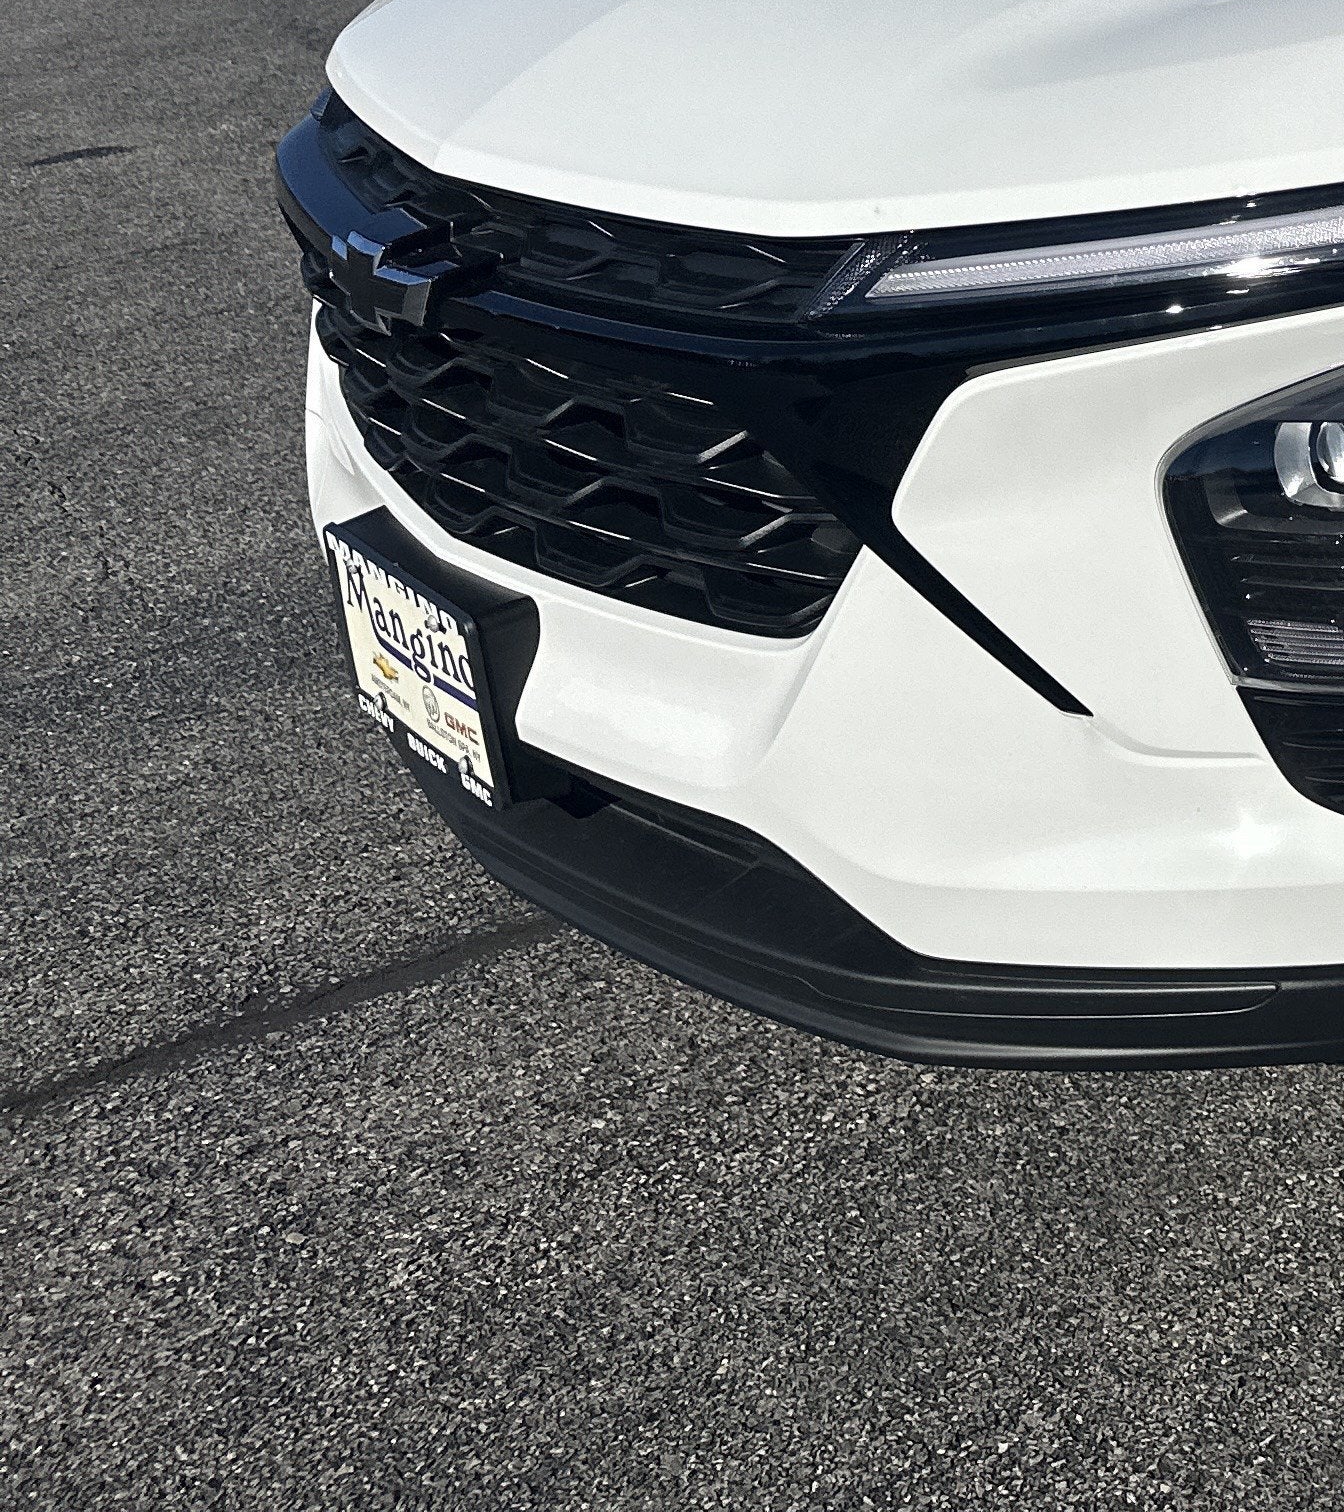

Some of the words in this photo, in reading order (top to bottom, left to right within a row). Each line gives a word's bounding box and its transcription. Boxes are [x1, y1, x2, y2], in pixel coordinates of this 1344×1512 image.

[345, 560, 475, 689] Mangino
[358, 693, 394, 733] CHEVY
[407, 732, 447, 774] BUICK
[460, 773, 493, 807] GMC
[444, 711, 480, 746] GMC
